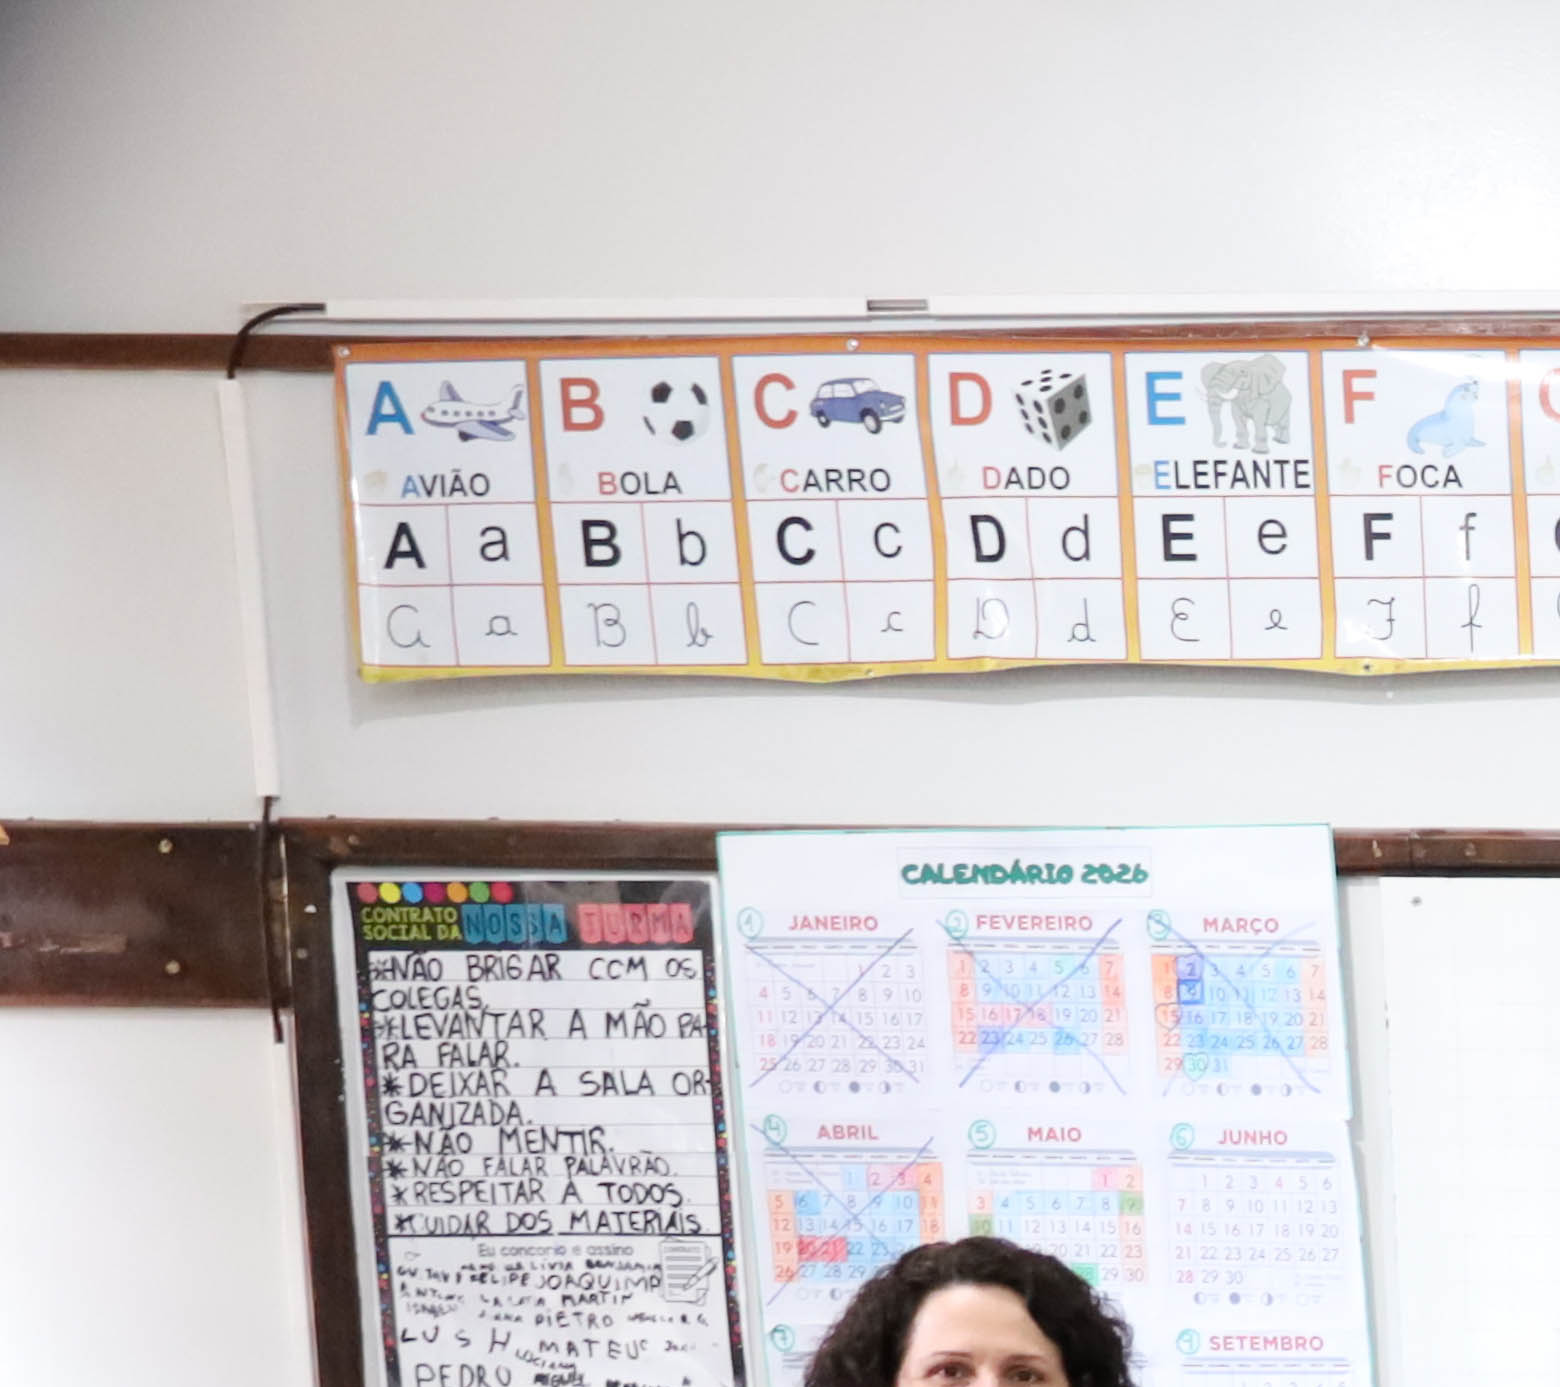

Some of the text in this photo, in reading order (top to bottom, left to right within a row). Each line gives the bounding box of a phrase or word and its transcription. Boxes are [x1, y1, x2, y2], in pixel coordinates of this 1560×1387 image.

[365, 380, 413, 436] A
[400, 466, 490, 499] AVIÃO
[597, 470, 682, 498] BOLA
[779, 466, 891, 494] CARRO
[981, 463, 1070, 493] DADO
[1153, 459, 1311, 491] ELEFANTE
[1377, 463, 1464, 490] FOCA
[901, 861, 1149, 886] CALENDÁRIO 2026
[362, 907, 457, 923] CONTRATO
[364, 923, 426, 940] SOCIAL
[432, 925, 461, 941] DA
[465, 911, 565, 937] NOSSA
[789, 915, 879, 931] JANEIRO
[976, 915, 1093, 931] FEVEREIRO
[467, 956, 562, 981] BRIGAR
[666, 961, 695, 978] OS
[398, 1000, 664, 1039] LEVANTAR A MÃO
[384, 1041, 519, 1068] RA FALAR.
[409, 1070, 654, 1097] DEIXAR A SALA
[500, 1128, 615, 1155] MENTIR.
[817, 1124, 879, 1141] ABRIL
[1217, 1128, 1288, 1145] JUNHO
[484, 1157, 548, 1177] FALAR
[416, 1181, 543, 1203] RESPEITAR
[506, 1211, 552, 1234] DOS
[1210, 1336, 1324, 1351] SETEMBRO
